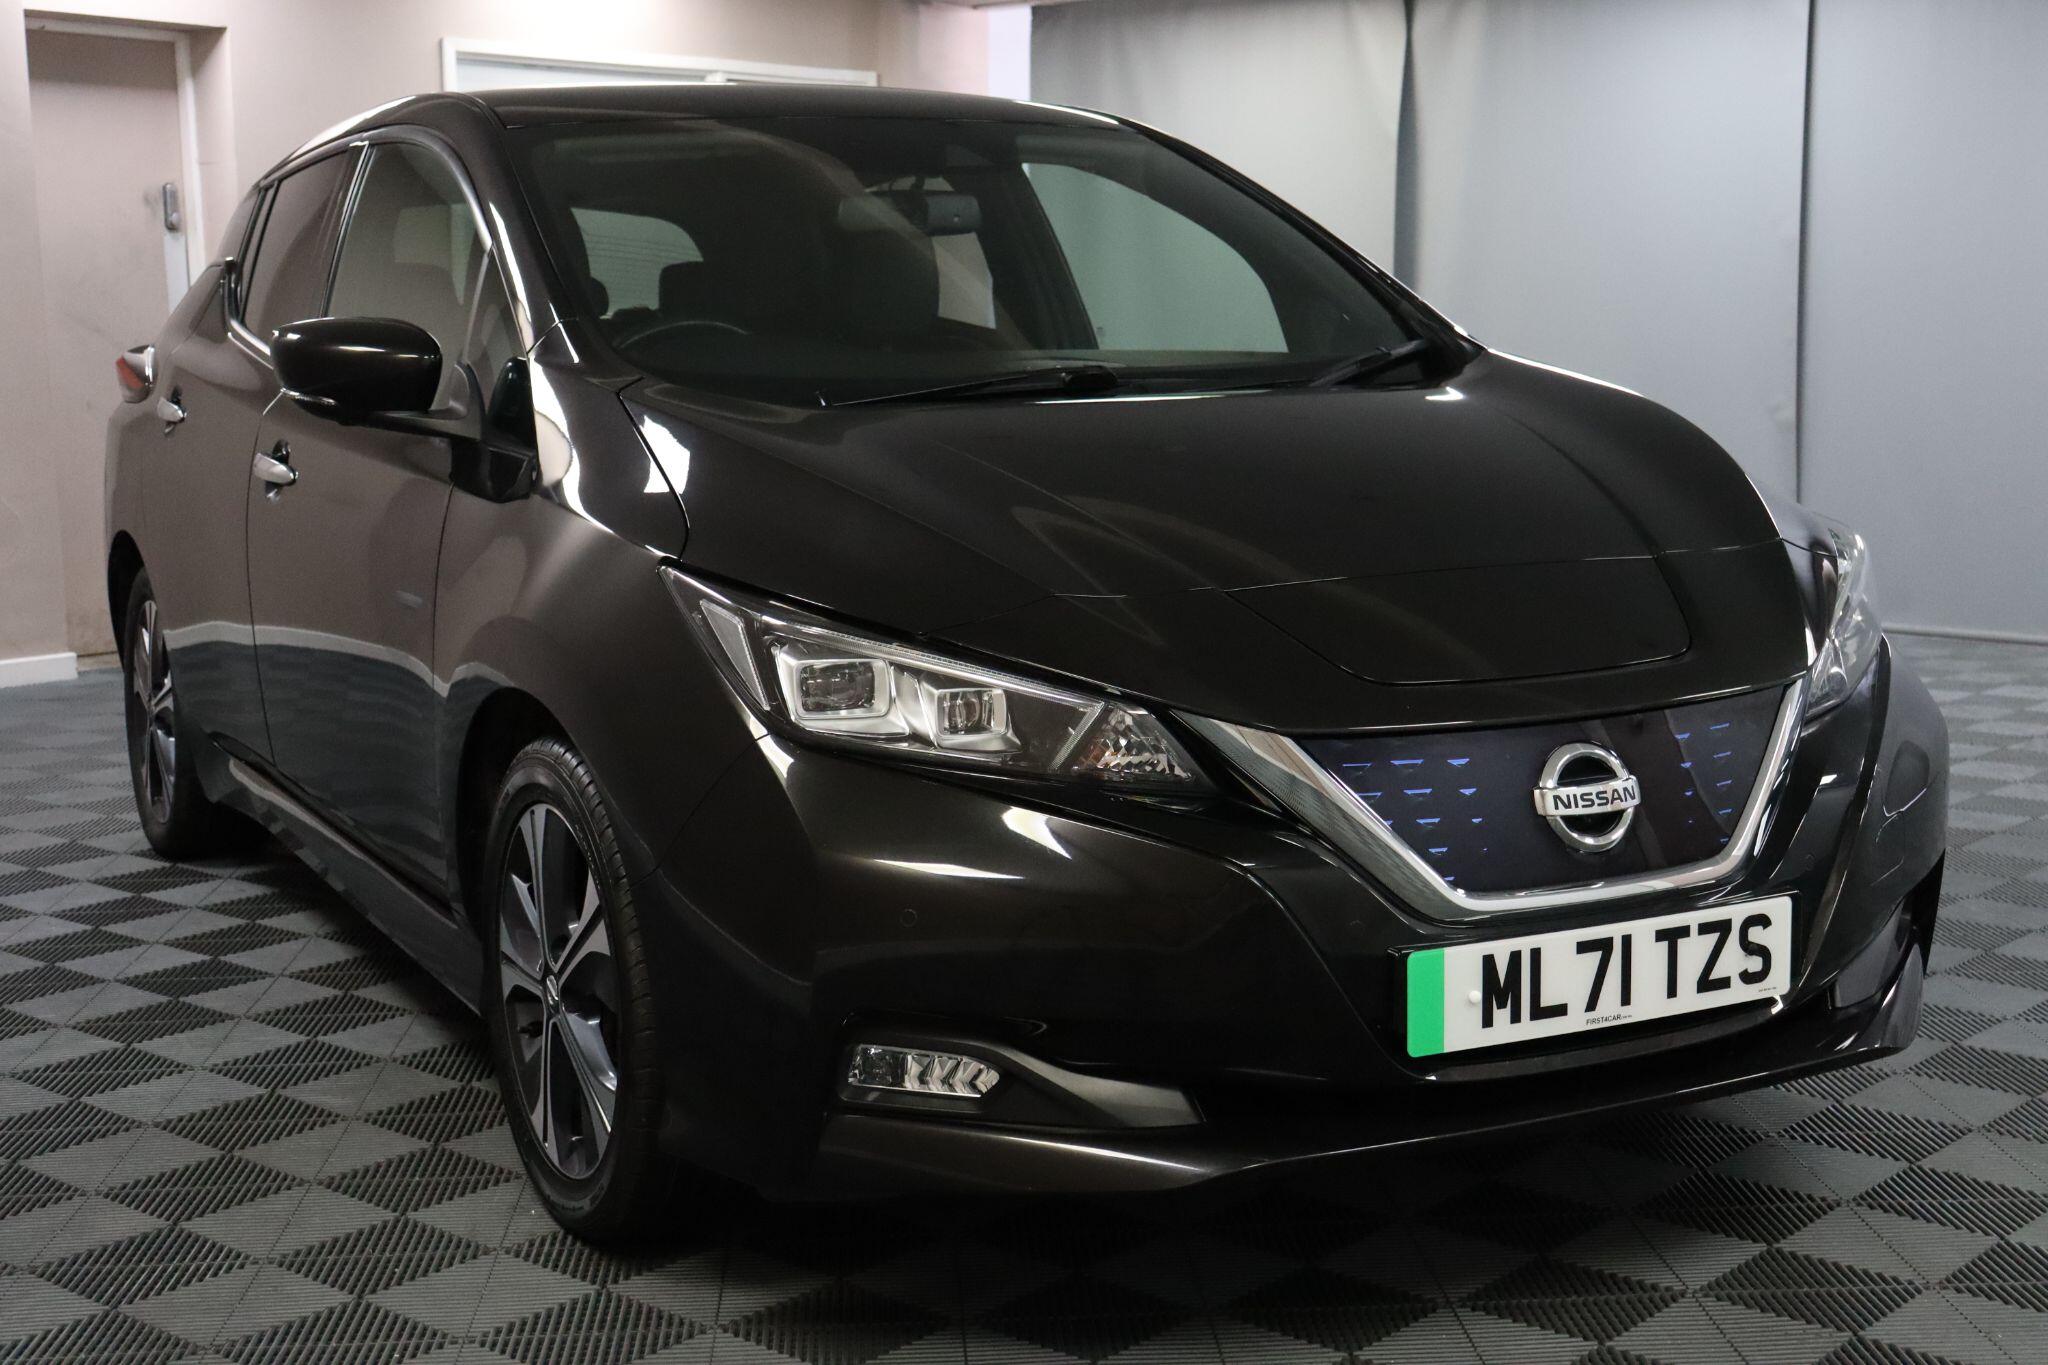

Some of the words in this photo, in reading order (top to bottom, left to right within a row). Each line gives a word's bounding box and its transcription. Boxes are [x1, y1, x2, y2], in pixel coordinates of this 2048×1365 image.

[1552, 785, 1636, 811] NISSAN
[1482, 947, 1568, 1028] ML
[1576, 934, 1632, 1012] 71
[1656, 913, 1772, 999] TZS
